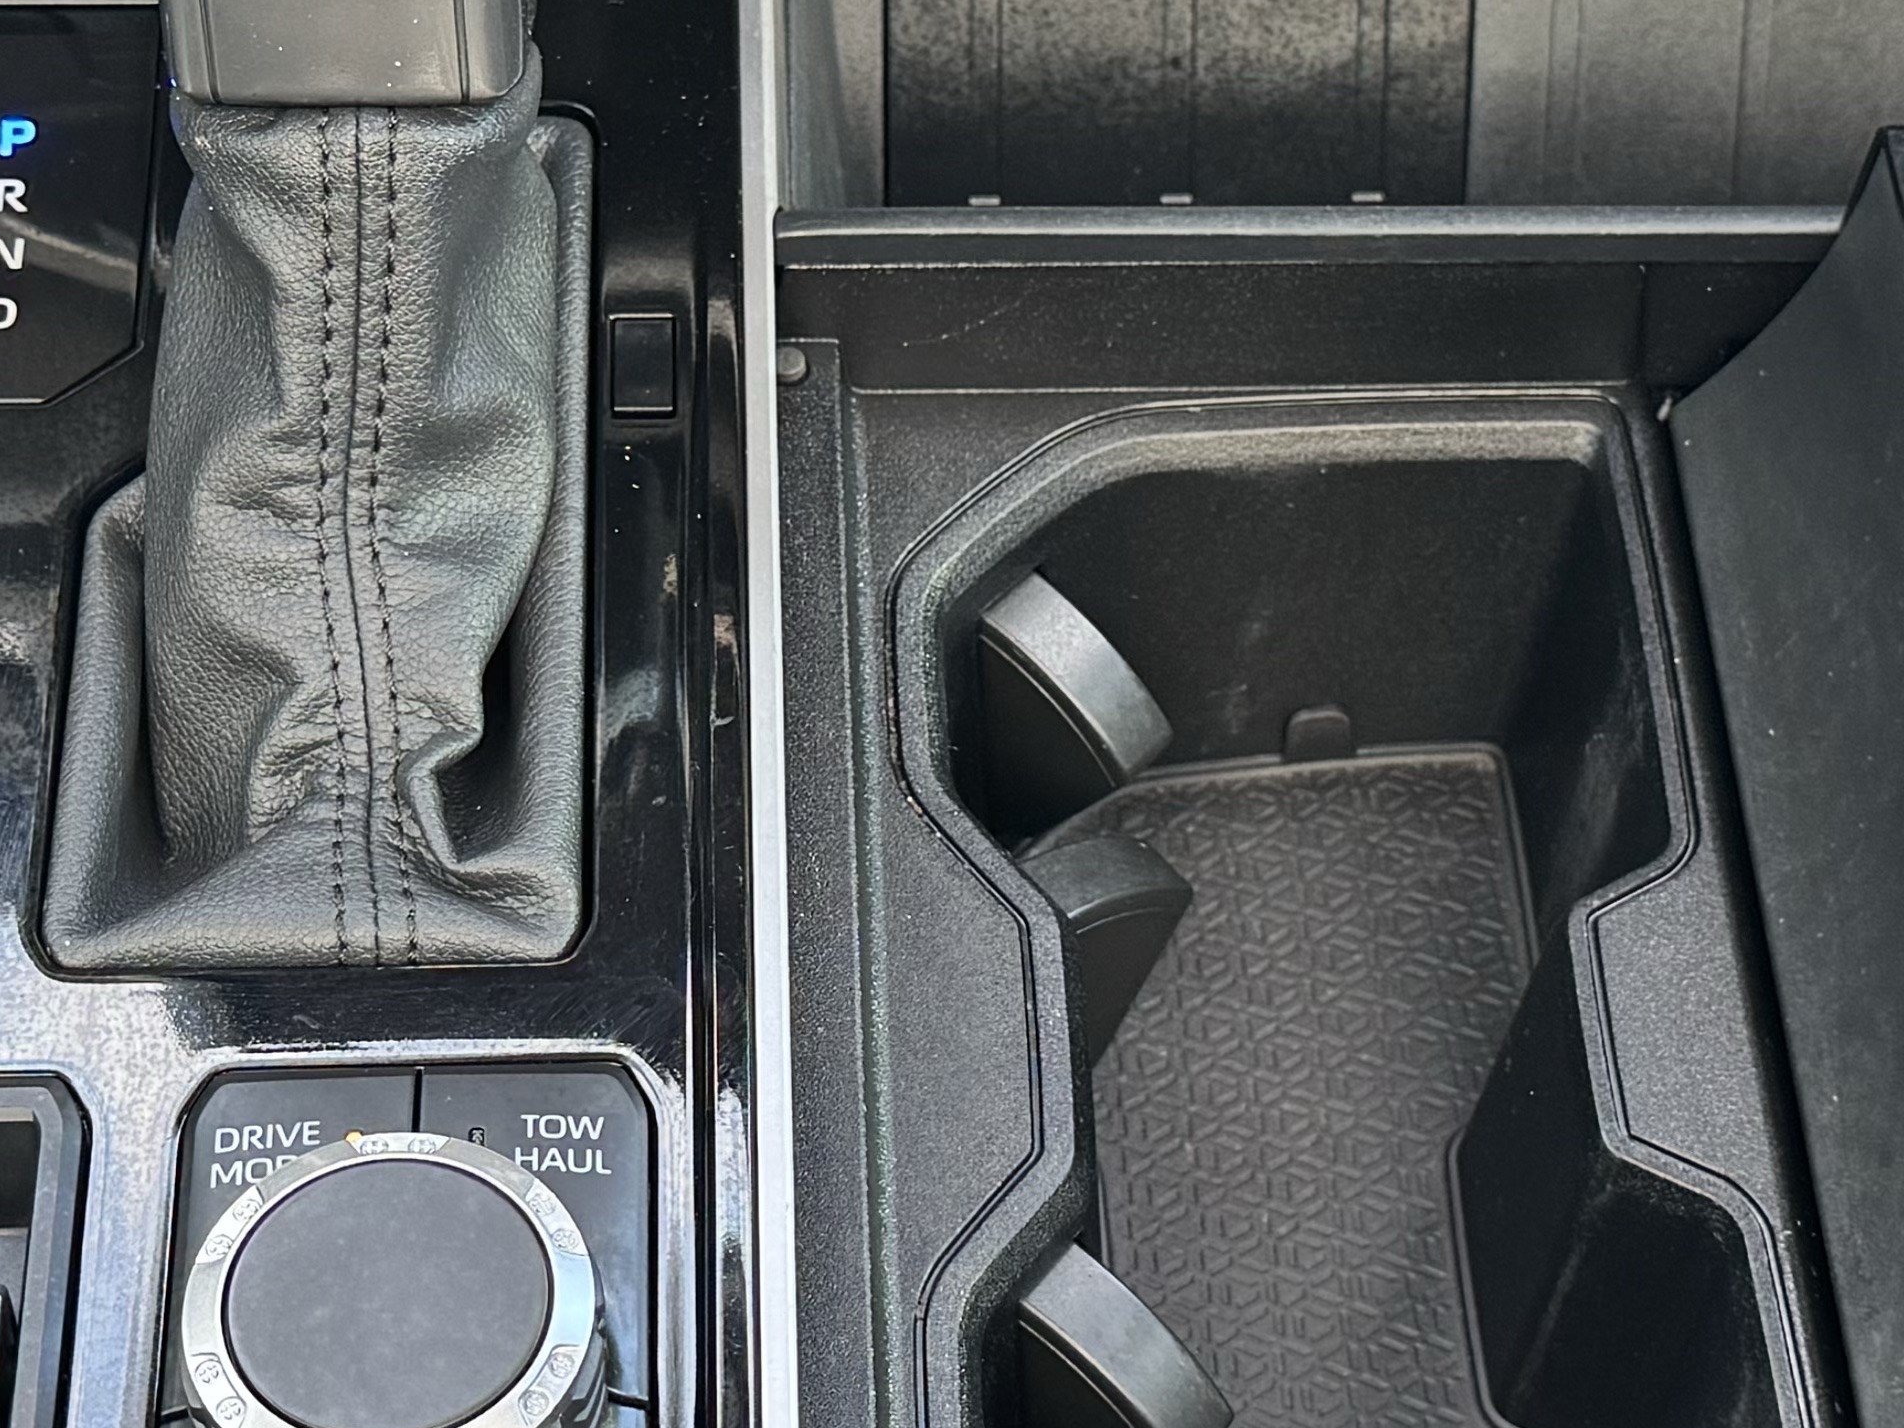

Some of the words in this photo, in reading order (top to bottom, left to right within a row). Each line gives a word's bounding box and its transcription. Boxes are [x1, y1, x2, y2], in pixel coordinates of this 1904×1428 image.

[214, 1119, 321, 1154] DRIVE
[520, 1113, 605, 1141] TOW
[209, 1154, 299, 1189] MO
[515, 1147, 613, 1175] HAUL
